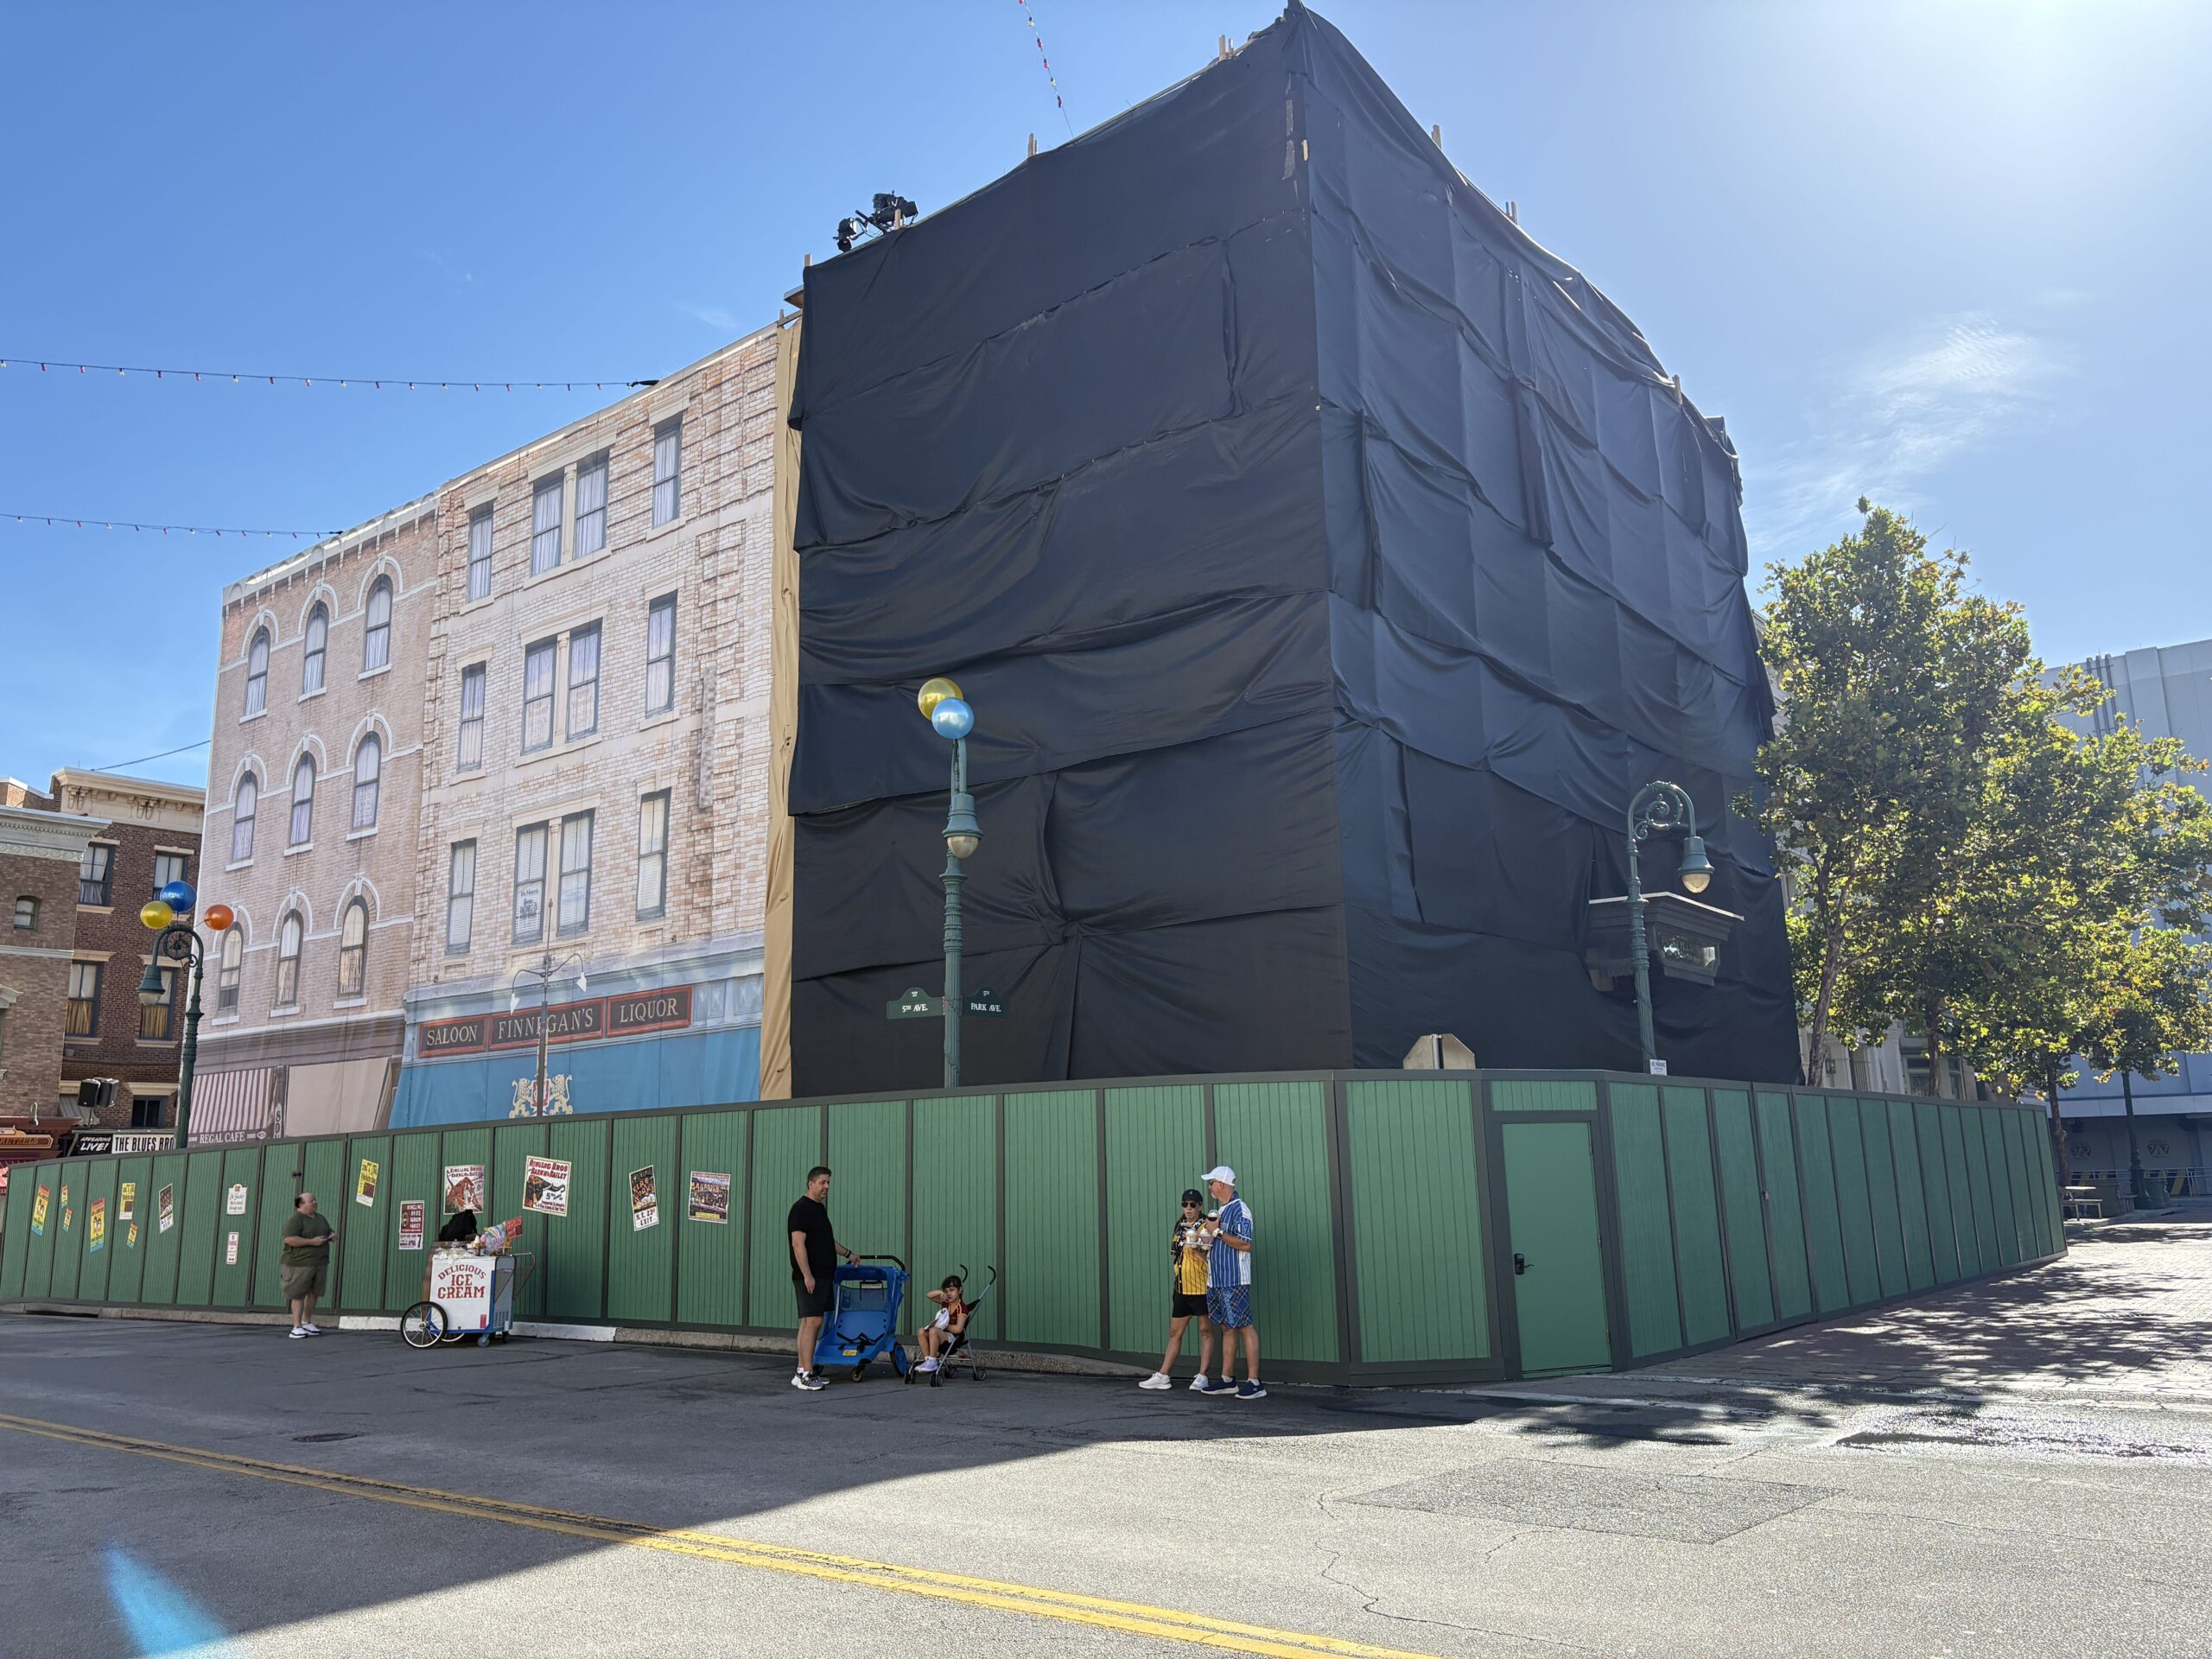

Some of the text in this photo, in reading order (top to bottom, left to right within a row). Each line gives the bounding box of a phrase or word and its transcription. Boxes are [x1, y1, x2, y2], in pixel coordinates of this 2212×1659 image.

[970, 1002, 987, 1011] PARK
[427, 998, 678, 1046] SALOON FINNEGAN'S LIQUOR
[115, 1137, 130, 1151] THE
[132, 1137, 156, 1151] BLUES
[200, 1134, 224, 1144] REGAL
[226, 1132, 245, 1142] CAFE
[80, 1142, 109, 1151] LIVE!
[417, 1235, 422, 1249] 7
[437, 1264, 486, 1281] DELICIOUS
[451, 1274, 473, 1287] ICE
[437, 1286, 486, 1299] CREAM
